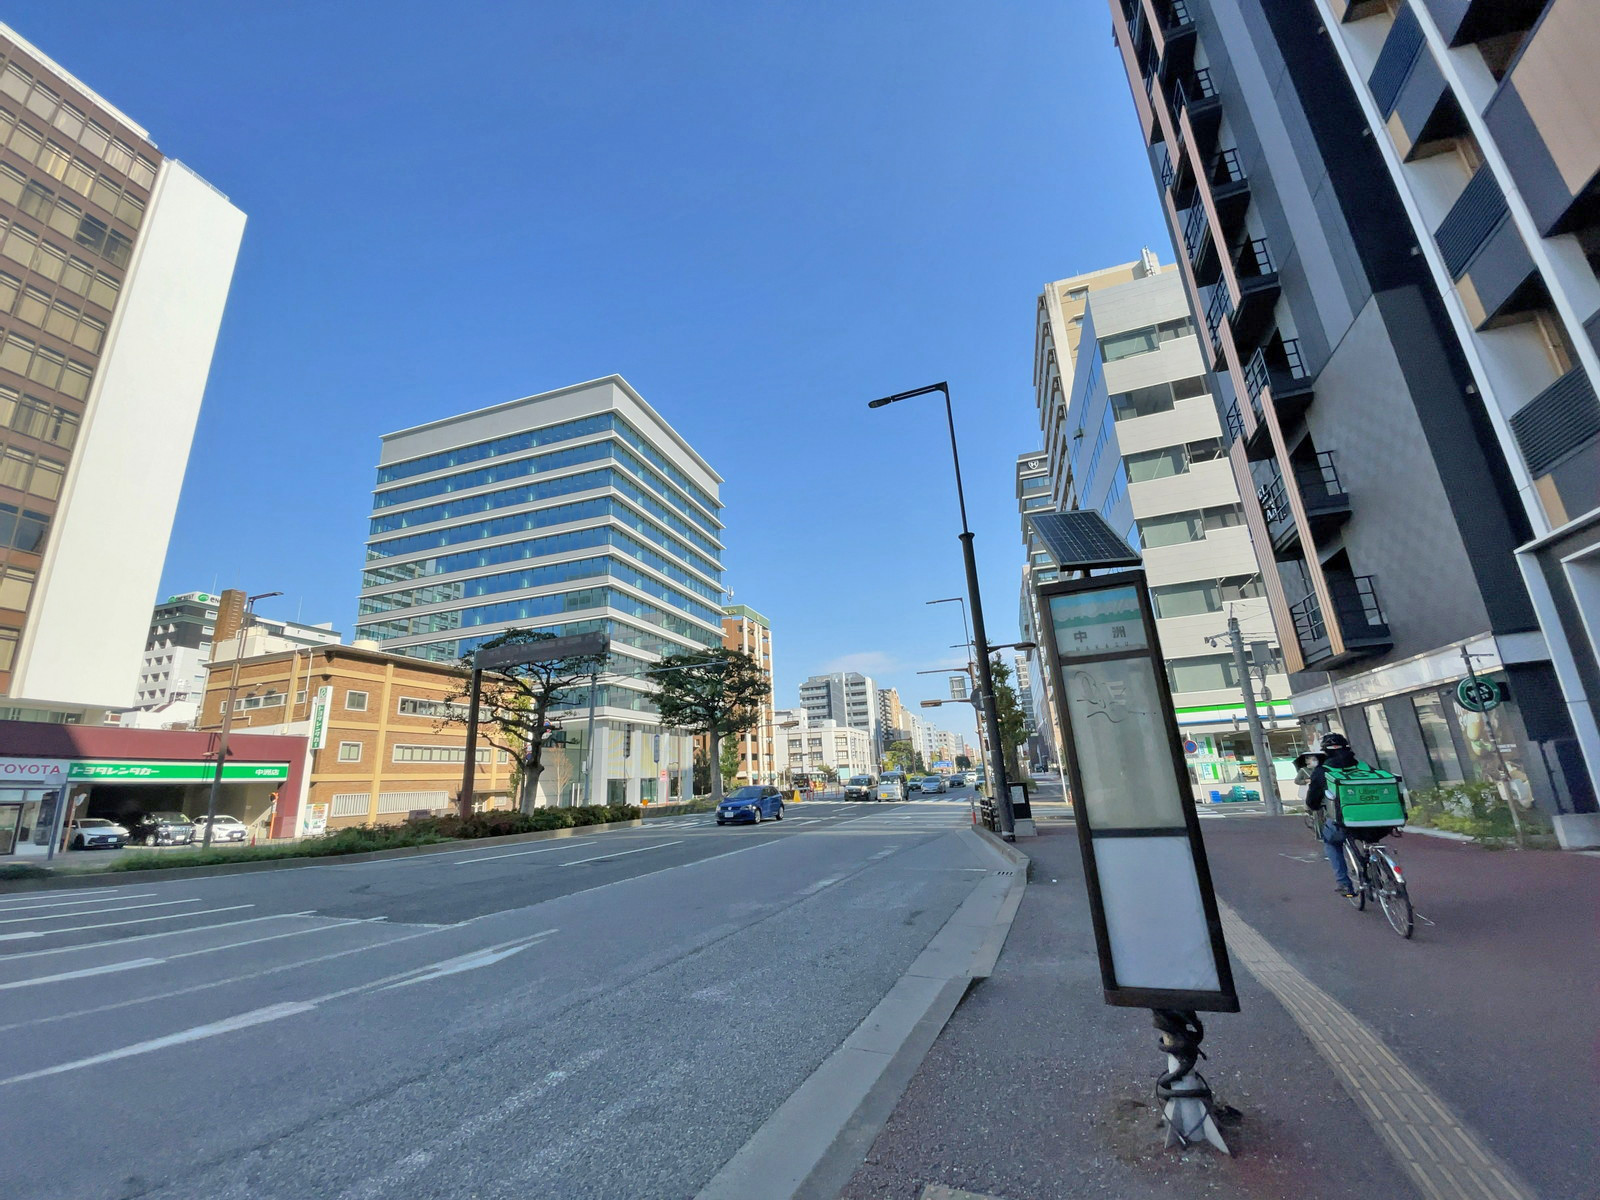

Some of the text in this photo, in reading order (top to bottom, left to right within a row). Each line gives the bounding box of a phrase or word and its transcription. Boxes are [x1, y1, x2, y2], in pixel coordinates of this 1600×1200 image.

[1073, 625, 1126, 643] 中洲
[313, 705, 324, 747] トヨタレンタカー
[72, 766, 160, 776] トヨタレンタカー
[1358, 787, 1378, 795] Uber
[1359, 794, 1380, 802] Eats
